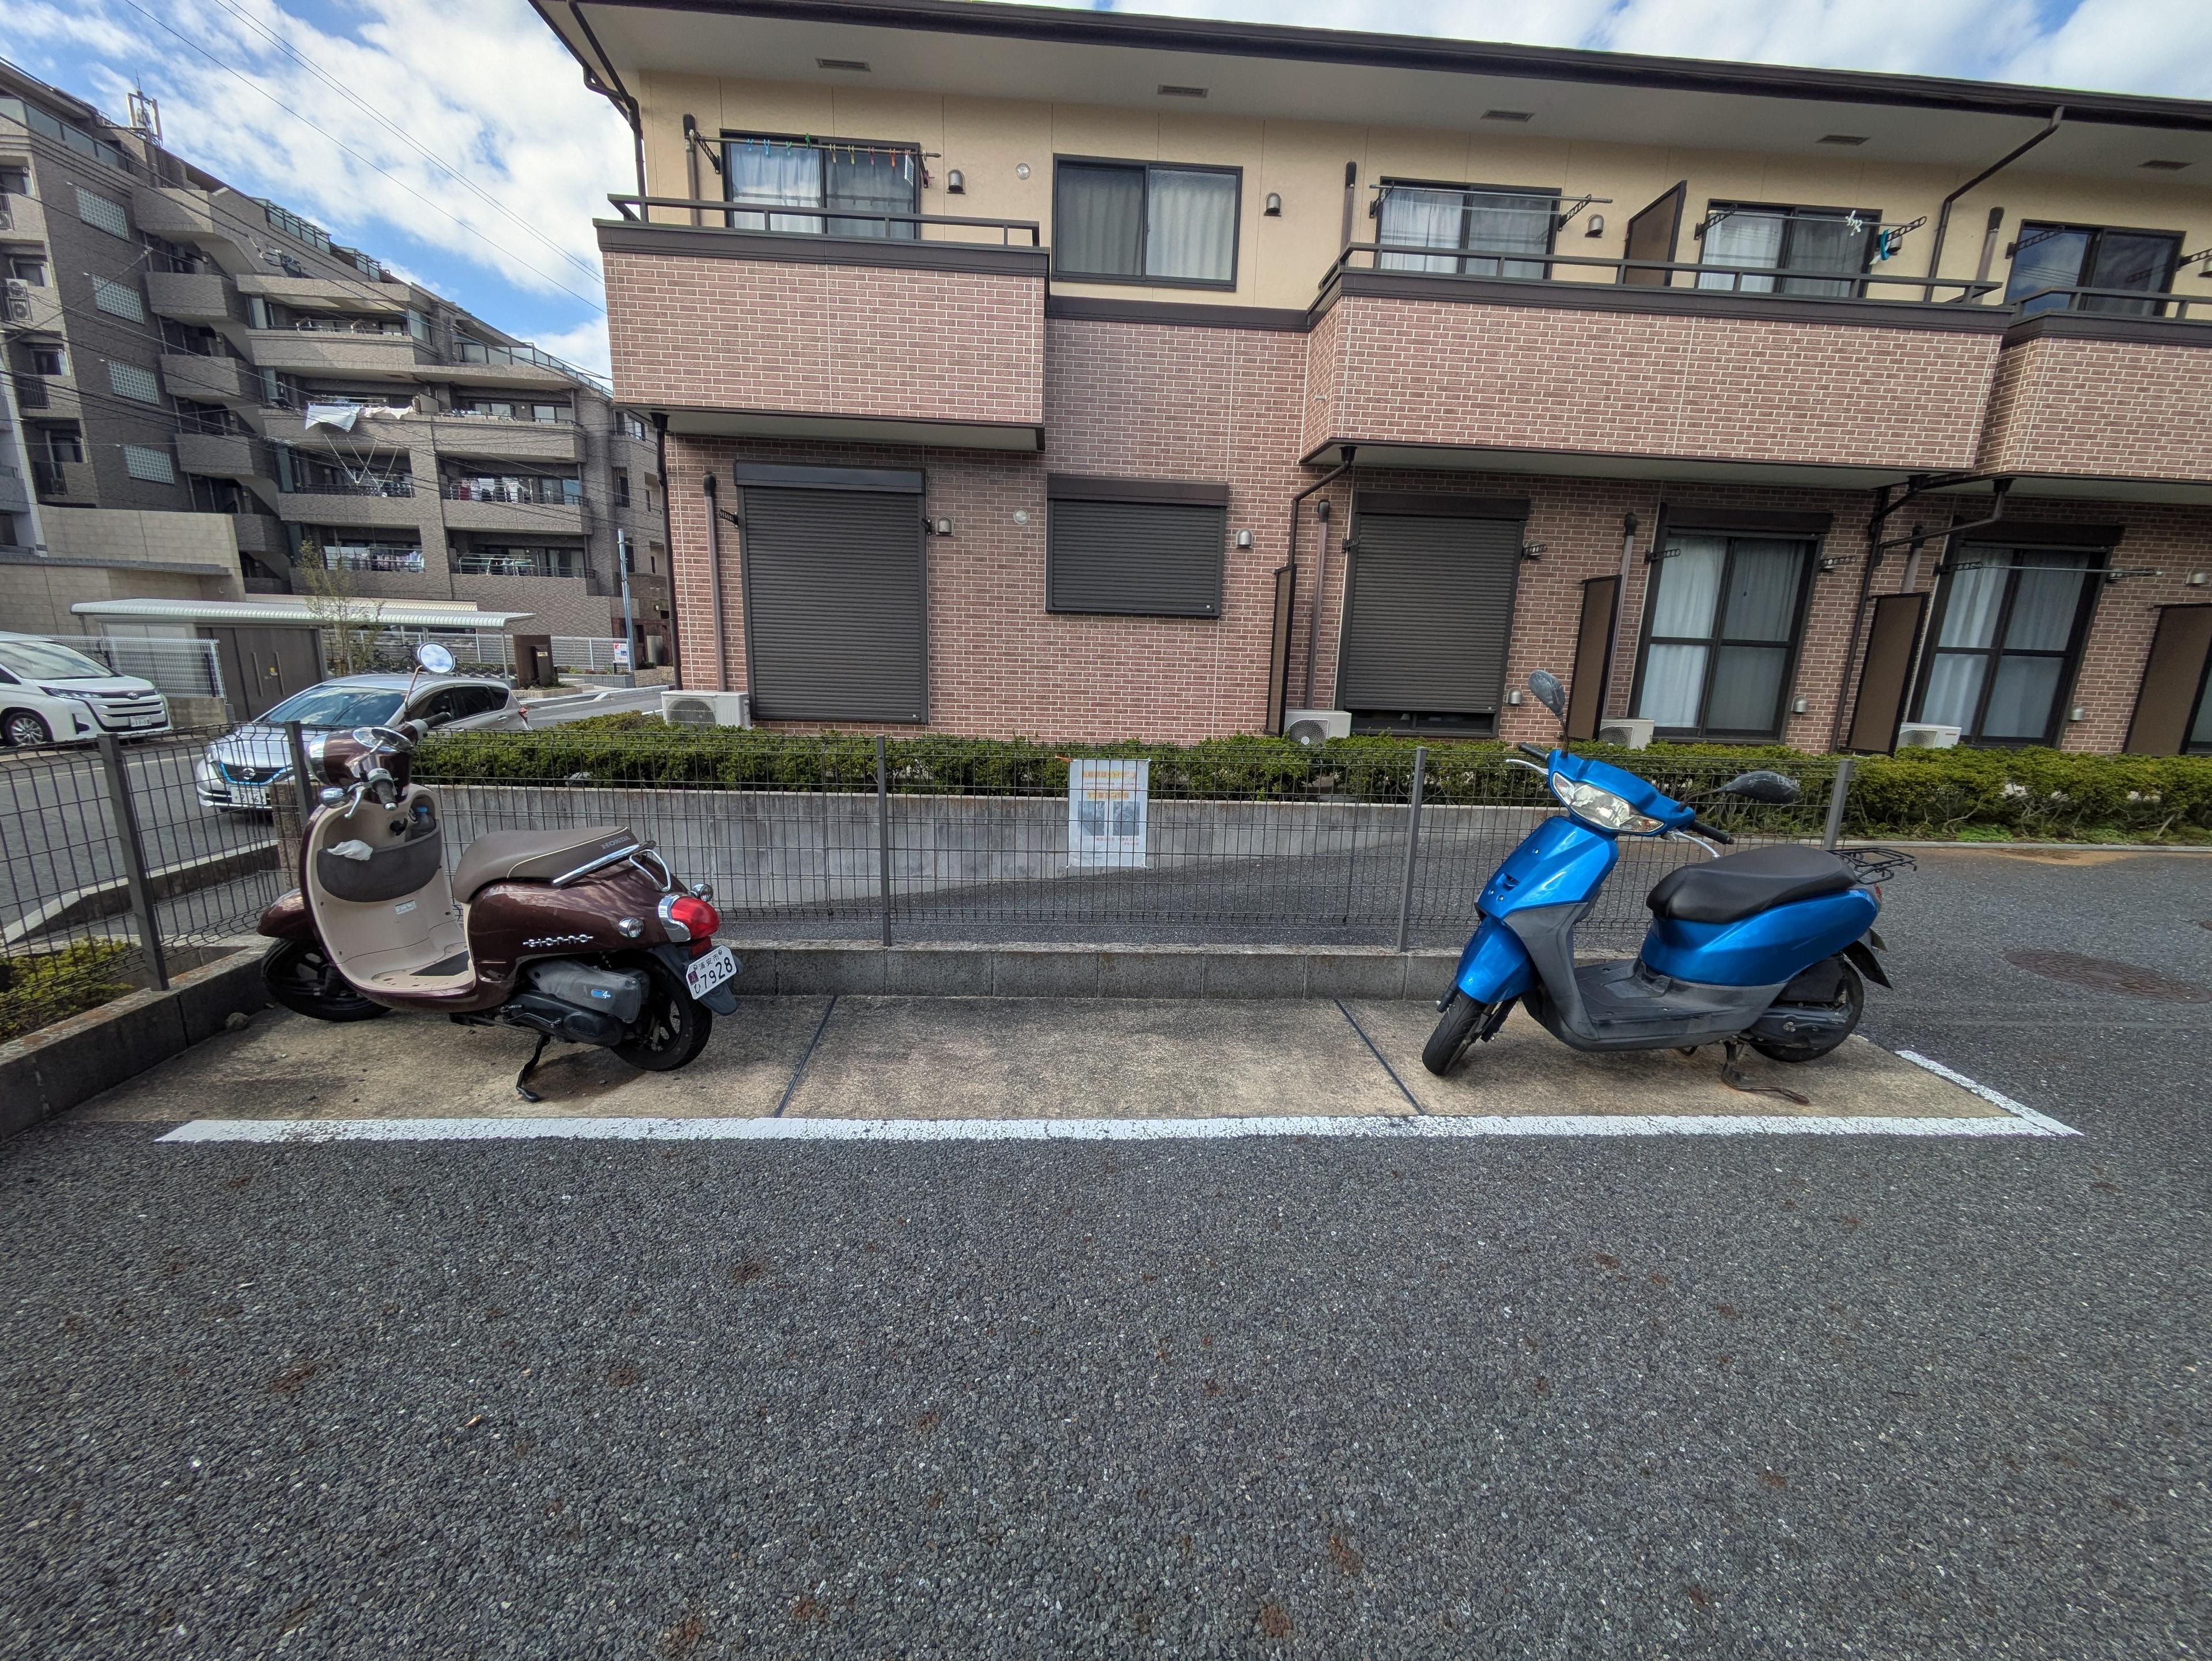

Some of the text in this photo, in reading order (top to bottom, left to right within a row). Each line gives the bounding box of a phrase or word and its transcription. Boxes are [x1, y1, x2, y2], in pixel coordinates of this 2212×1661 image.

[600, 836, 630, 849] HONDA
[698, 954, 719, 970] 浦安市
[694, 983, 701, 994] ひ
[700, 956, 733, 989] 7928
